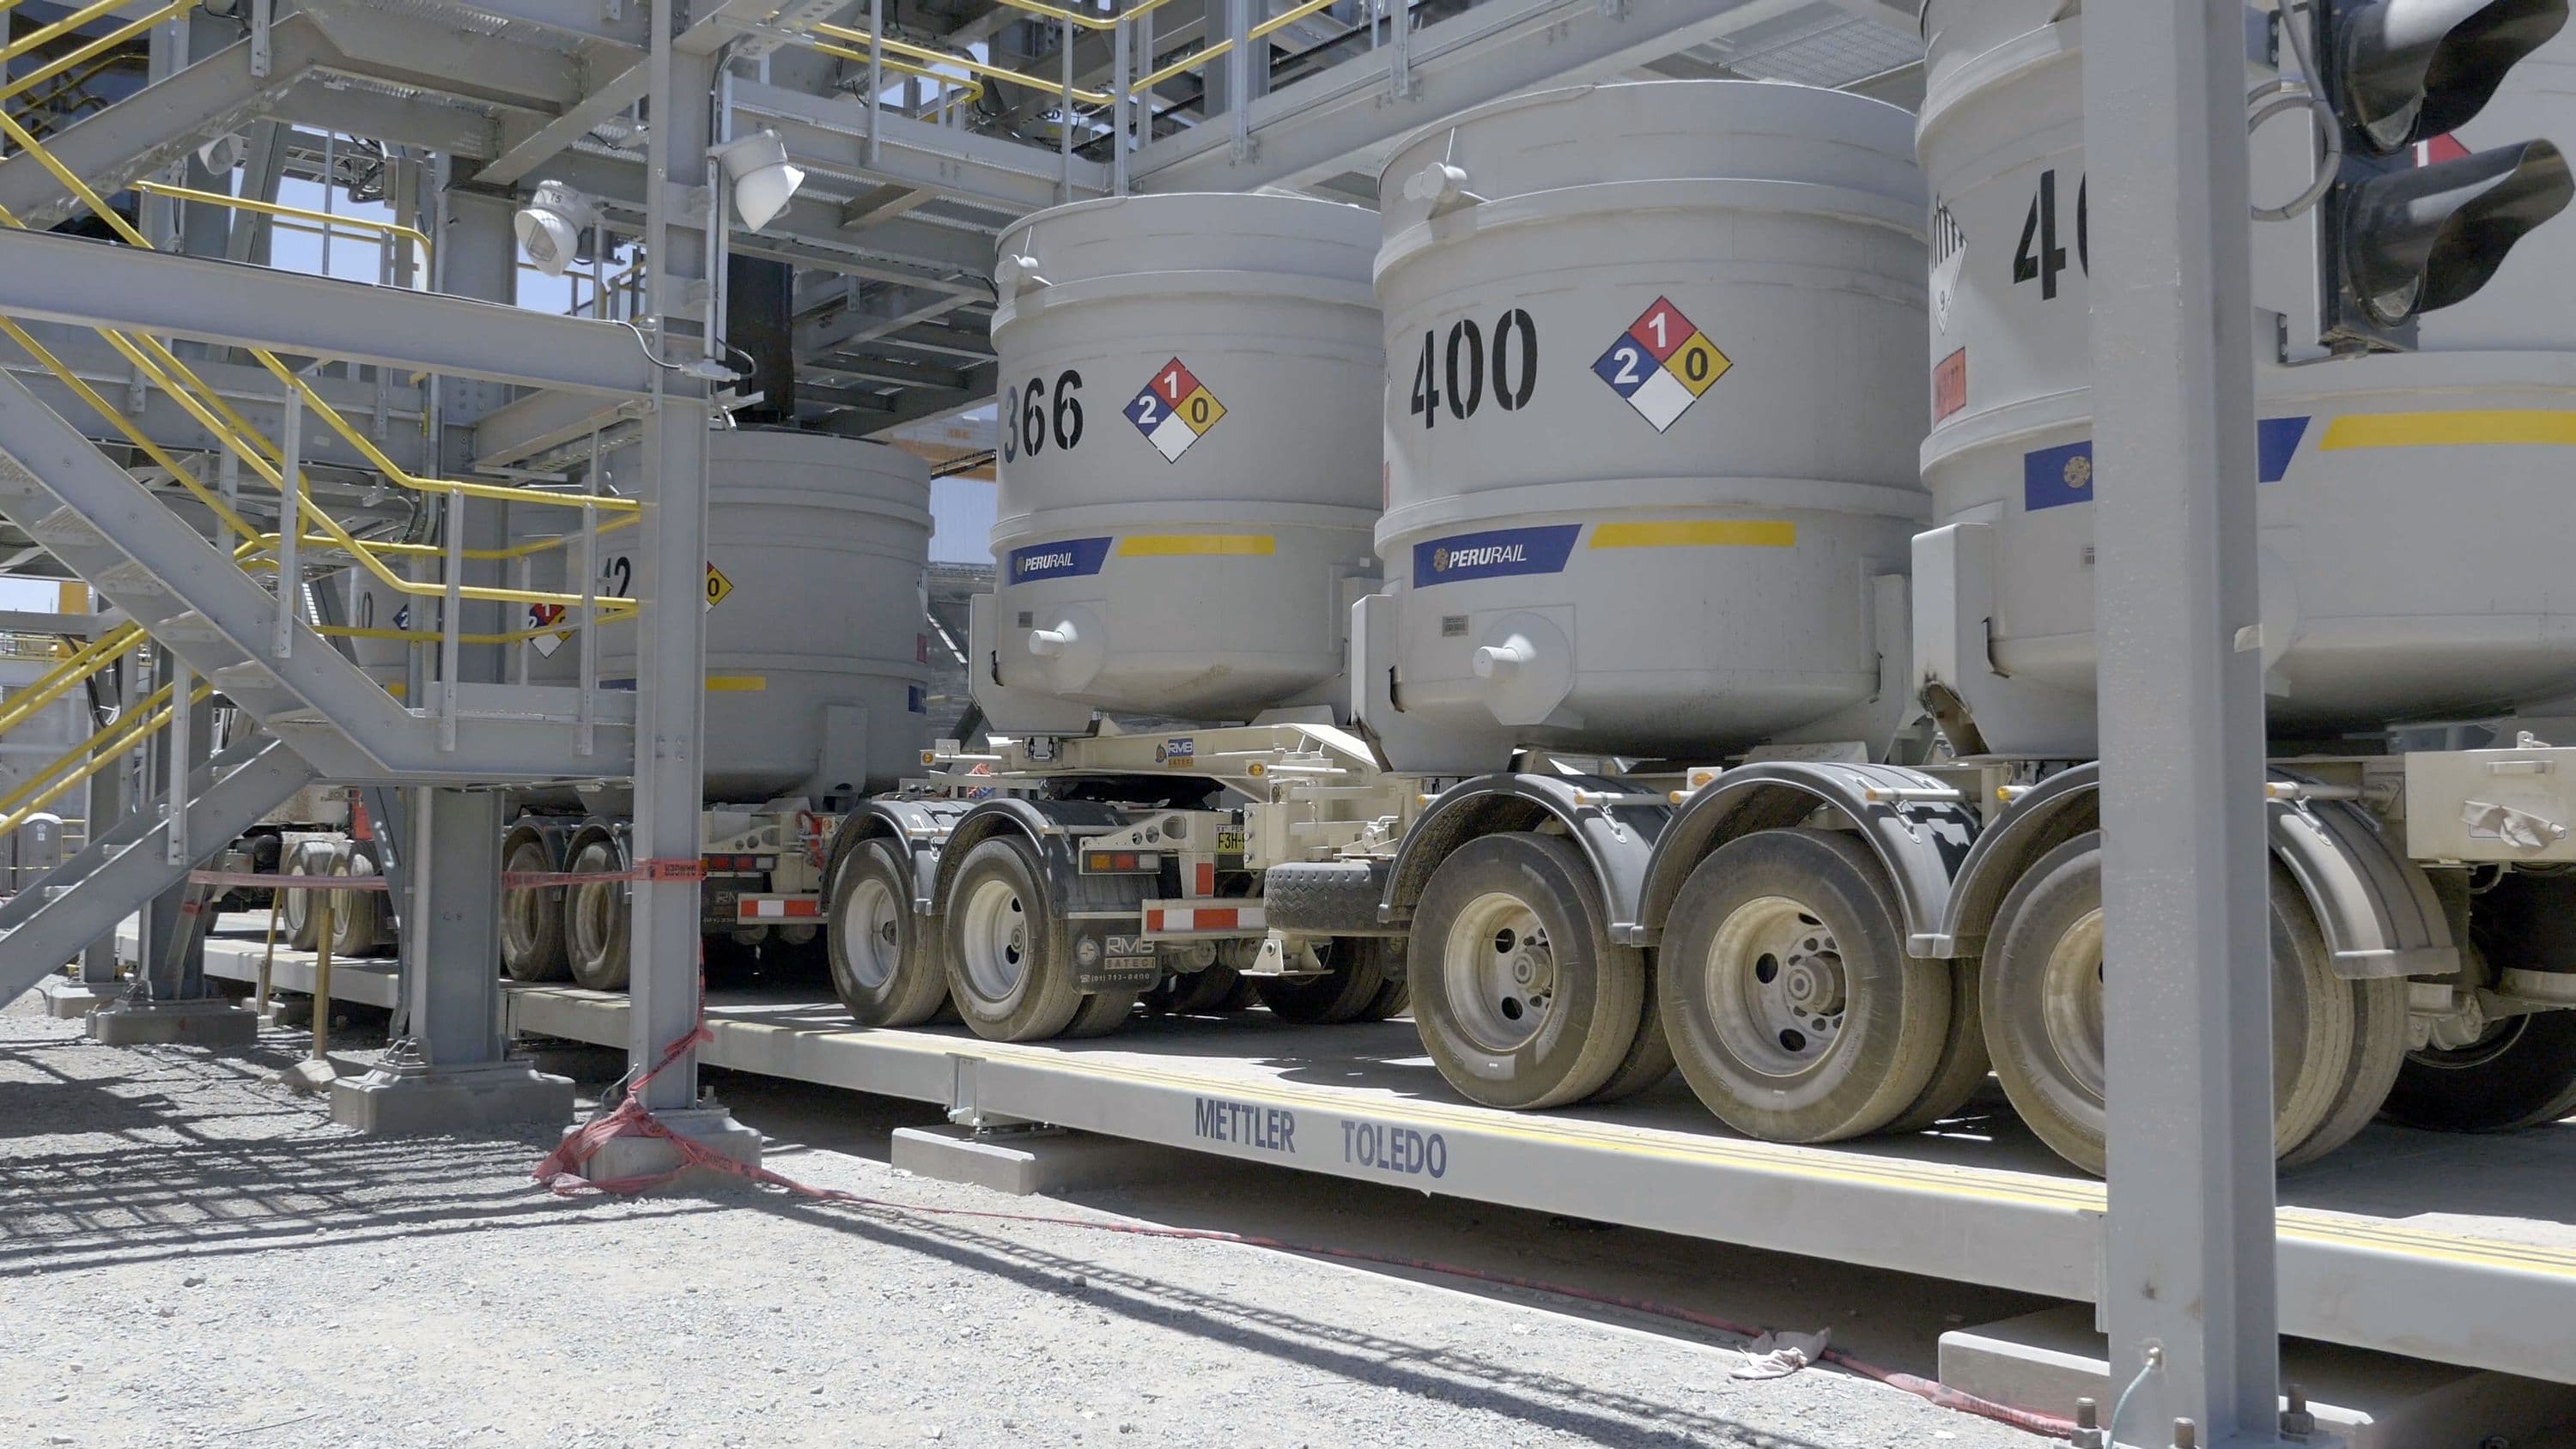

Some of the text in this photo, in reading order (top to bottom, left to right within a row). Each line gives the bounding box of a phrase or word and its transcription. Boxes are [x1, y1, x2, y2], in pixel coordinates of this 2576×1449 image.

[2014, 169, 2087, 300] 4
[1940, 289, 1946, 312] 9
[1648, 312, 1667, 349] 1
[1411, 308, 1538, 429] 400
[1614, 348, 1639, 385] 2
[1685, 347, 1708, 382] 0
[1163, 371, 1178, 399] 1
[1004, 369, 1084, 464] 366
[1138, 395, 1157, 424] 2
[1191, 397, 1209, 424] 0
[1024, 552, 1074, 573] PERURAIL
[1449, 543, 1528, 569] PERURAIL
[708, 577, 720, 597] 0
[400, 611, 410, 628] 2
[1168, 741, 1194, 754] RMB
[1106, 937, 1155, 955] RMB
[1195, 1097, 1448, 1179] METTLER TOLEDO
